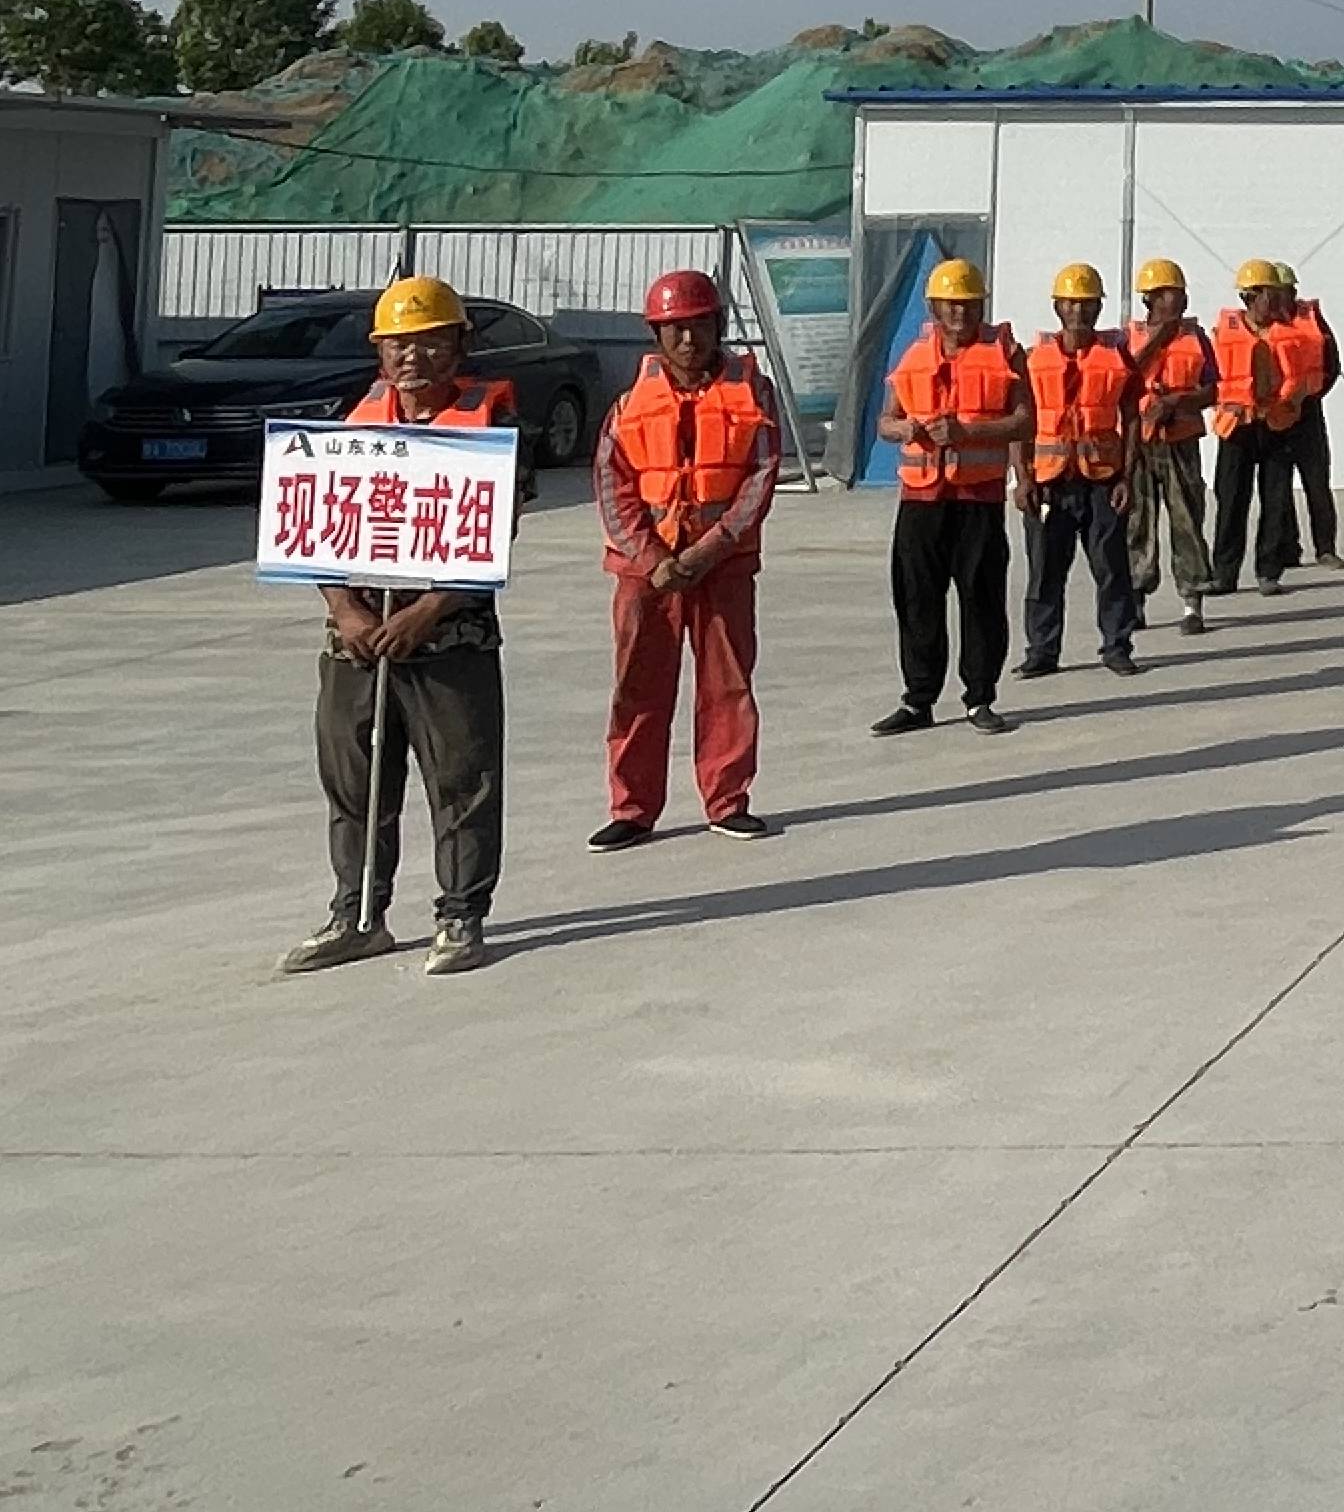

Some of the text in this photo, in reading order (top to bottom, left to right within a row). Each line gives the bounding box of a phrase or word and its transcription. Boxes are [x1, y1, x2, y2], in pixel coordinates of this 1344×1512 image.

[275, 471, 495, 563] 现场警戒组
